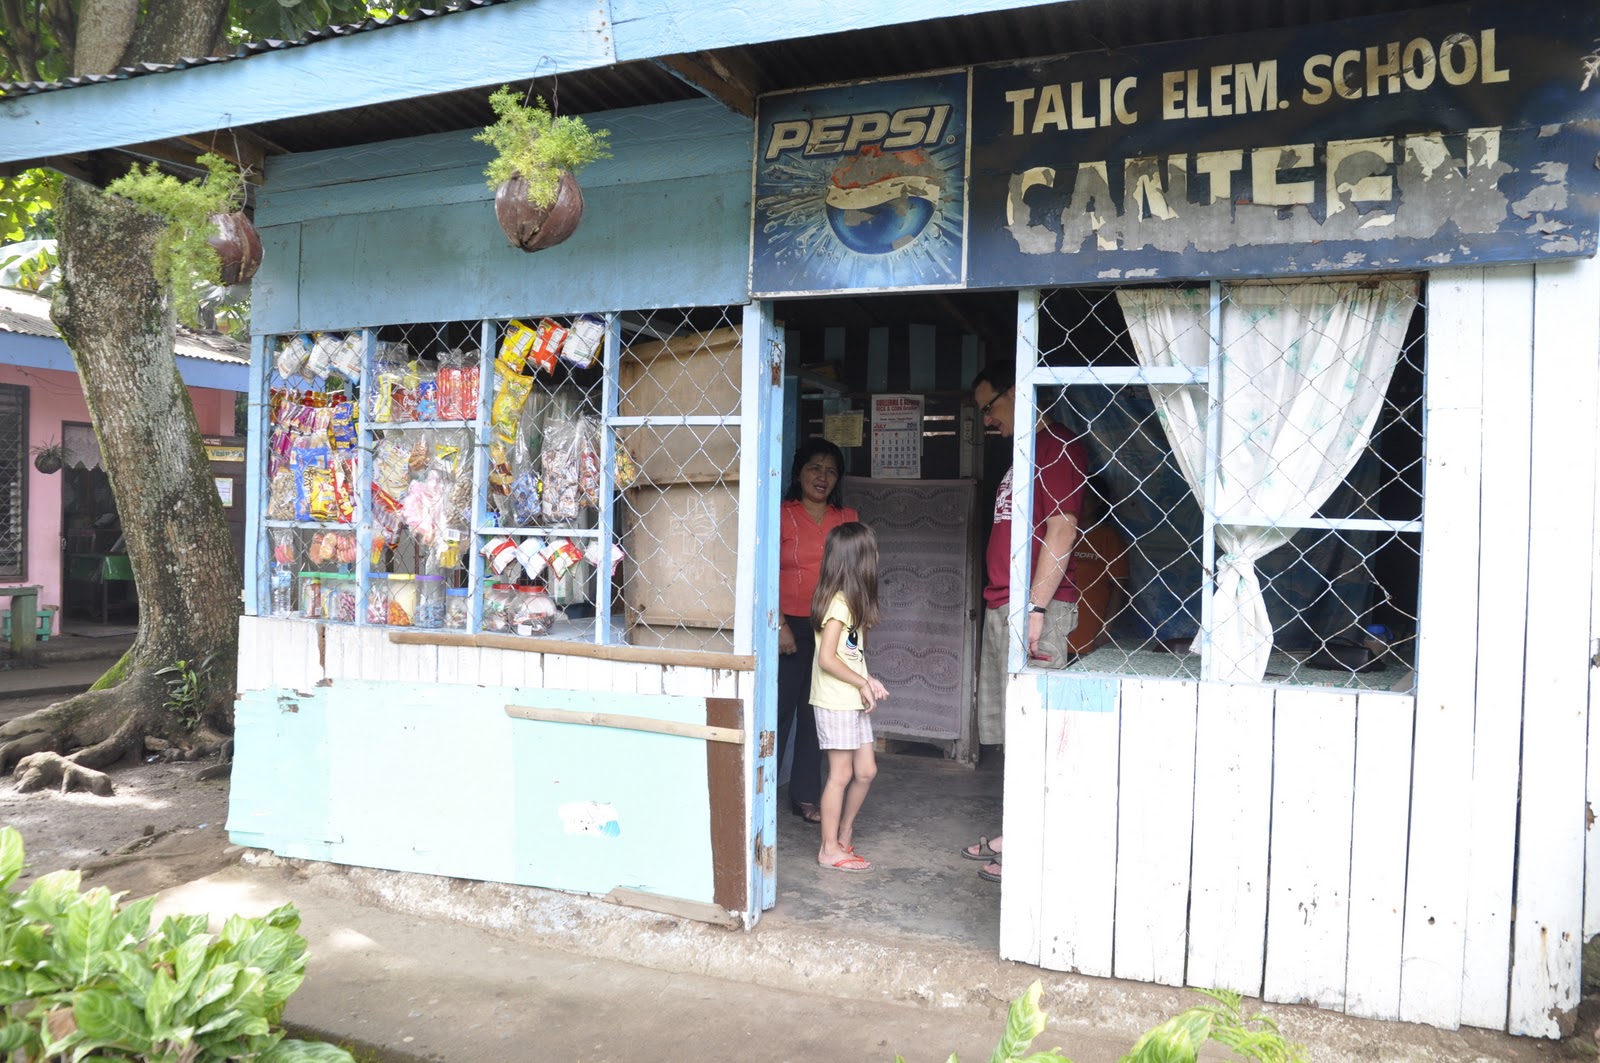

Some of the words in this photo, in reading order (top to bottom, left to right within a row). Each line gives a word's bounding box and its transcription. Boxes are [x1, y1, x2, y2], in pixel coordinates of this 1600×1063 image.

[765, 104, 951, 160] PEPSI
[1005, 76, 1138, 136] TALIC
[1162, 59, 1290, 121] ELEM.
[1302, 28, 1510, 106] SCHOOL
[1004, 126, 1504, 254] CANTEEN
